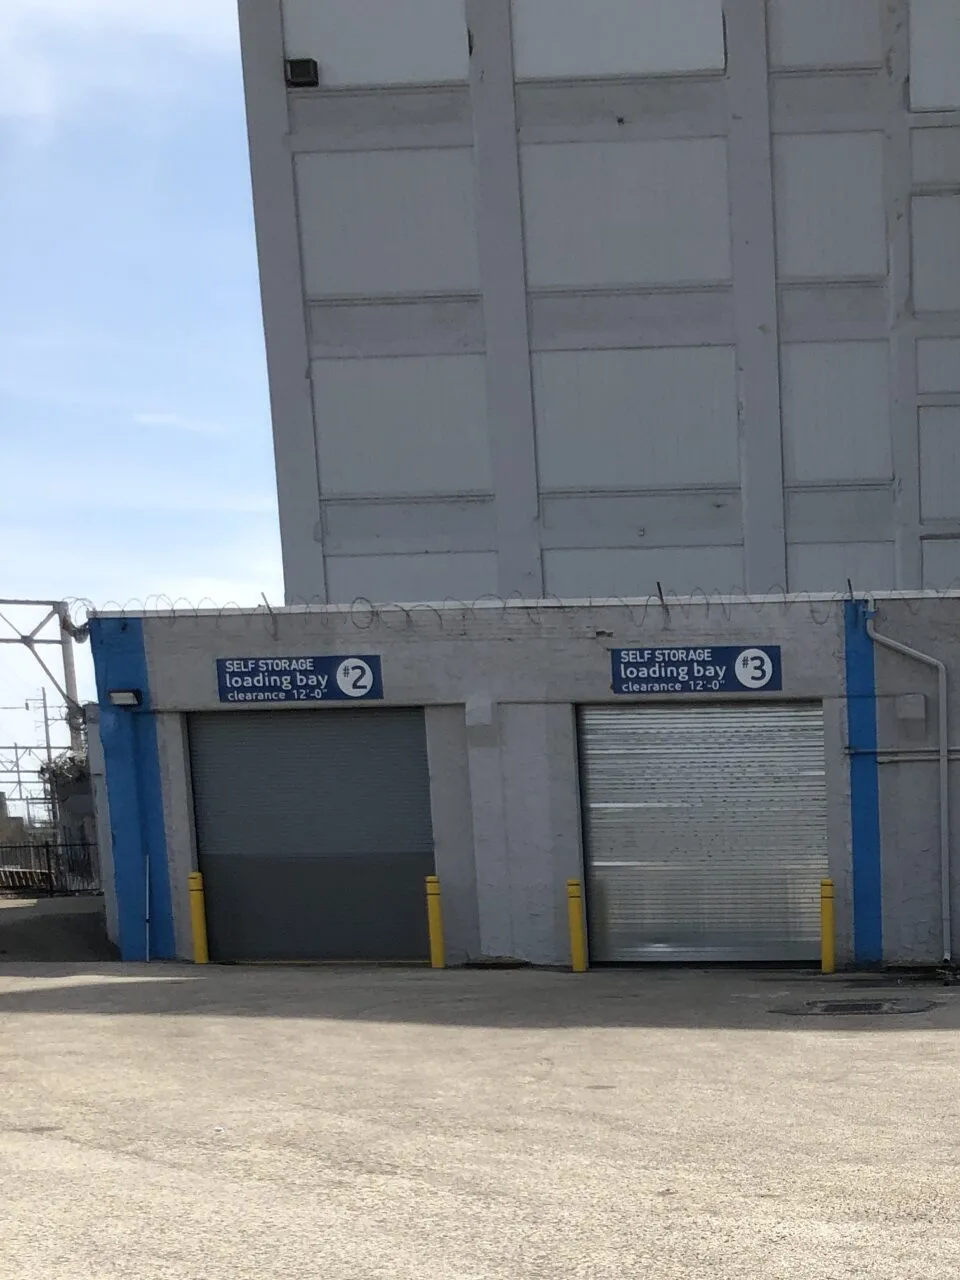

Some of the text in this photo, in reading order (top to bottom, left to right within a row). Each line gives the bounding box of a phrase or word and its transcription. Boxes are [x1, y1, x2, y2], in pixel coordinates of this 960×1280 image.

[620, 649, 712, 663] SELF STORAGE
[225, 659, 314, 672] SELF STORAGE
[620, 662, 726, 681] loading bay
[225, 672, 328, 689] loading bay
[622, 681, 682, 692] clearance
[227, 690, 286, 701] clearance
